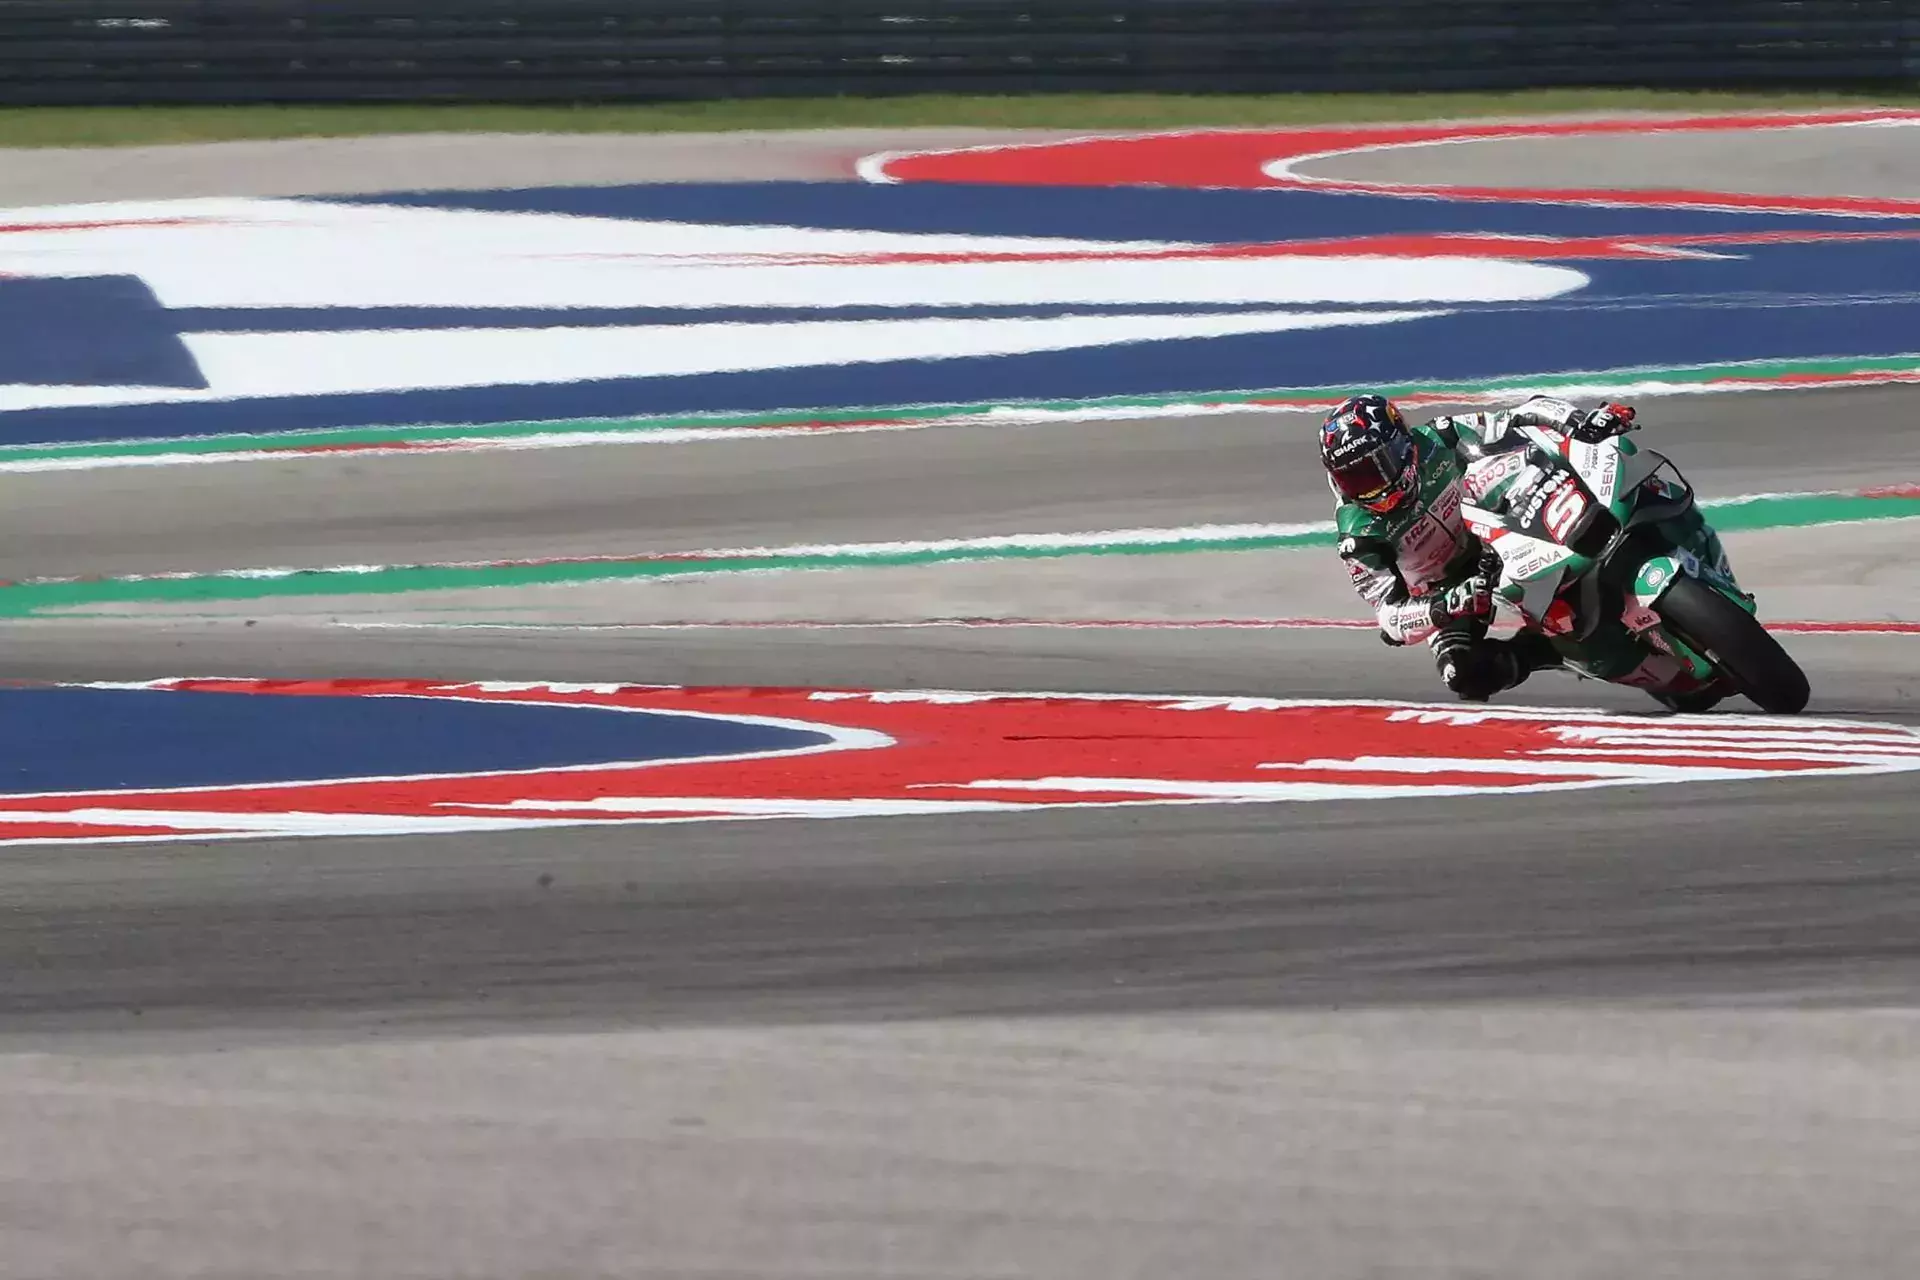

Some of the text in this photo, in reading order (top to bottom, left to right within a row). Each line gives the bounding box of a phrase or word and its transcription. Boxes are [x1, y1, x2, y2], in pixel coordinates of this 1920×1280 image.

[1333, 435, 1368, 457] SHARK
[1600, 451, 1618, 497] SENA
[1520, 468, 1570, 529] CUSTOM
[1516, 550, 1562, 578] SENA
